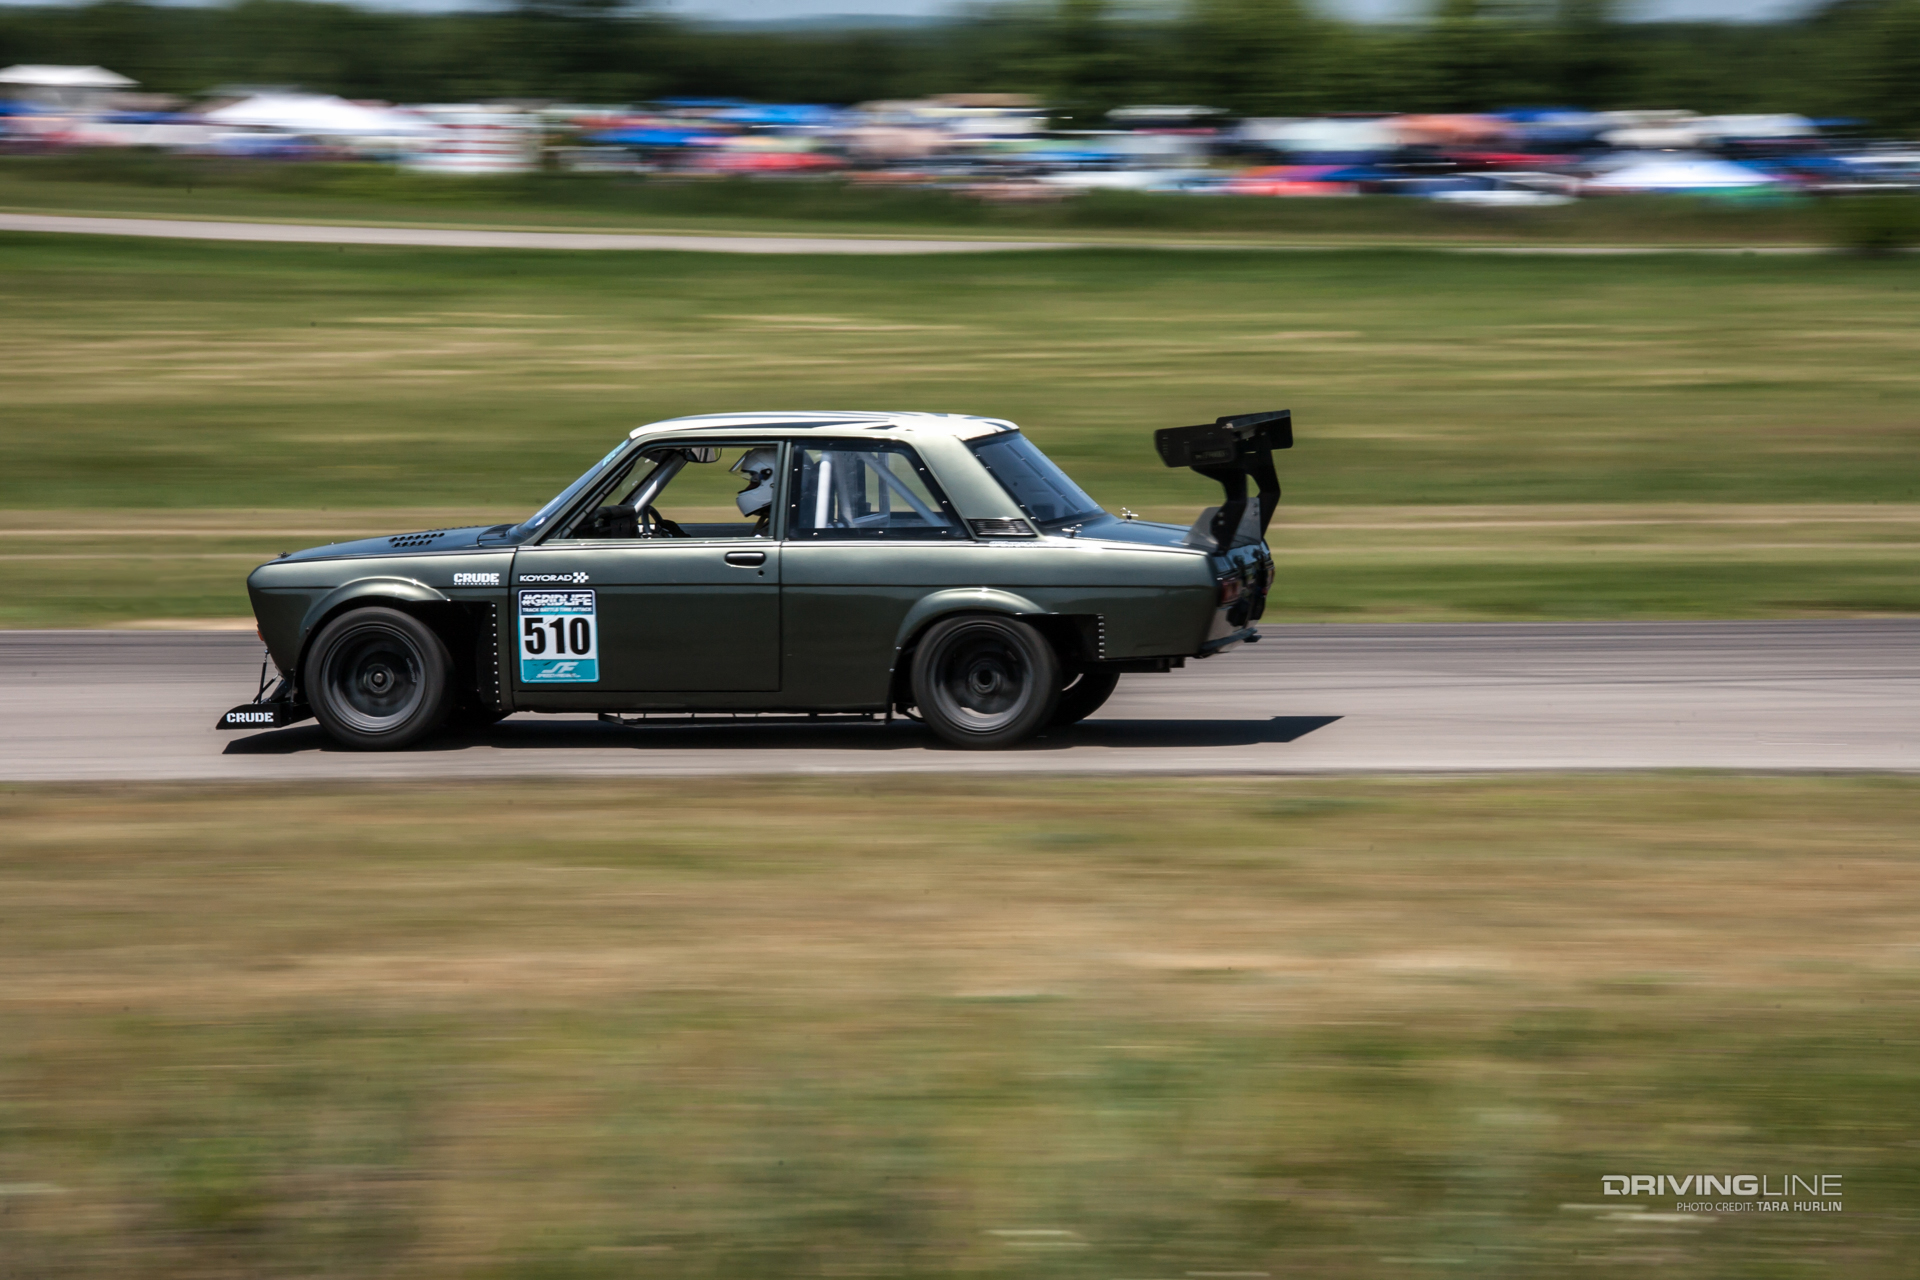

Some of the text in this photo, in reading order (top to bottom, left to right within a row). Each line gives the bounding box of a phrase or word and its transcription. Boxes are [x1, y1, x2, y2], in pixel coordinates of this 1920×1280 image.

[453, 573, 500, 583] CRUDE
[519, 574, 573, 582] KOYORAD
[521, 594, 593, 606] #GRIDLIFE
[524, 617, 591, 655] 510
[226, 712, 274, 723] CRUDE
